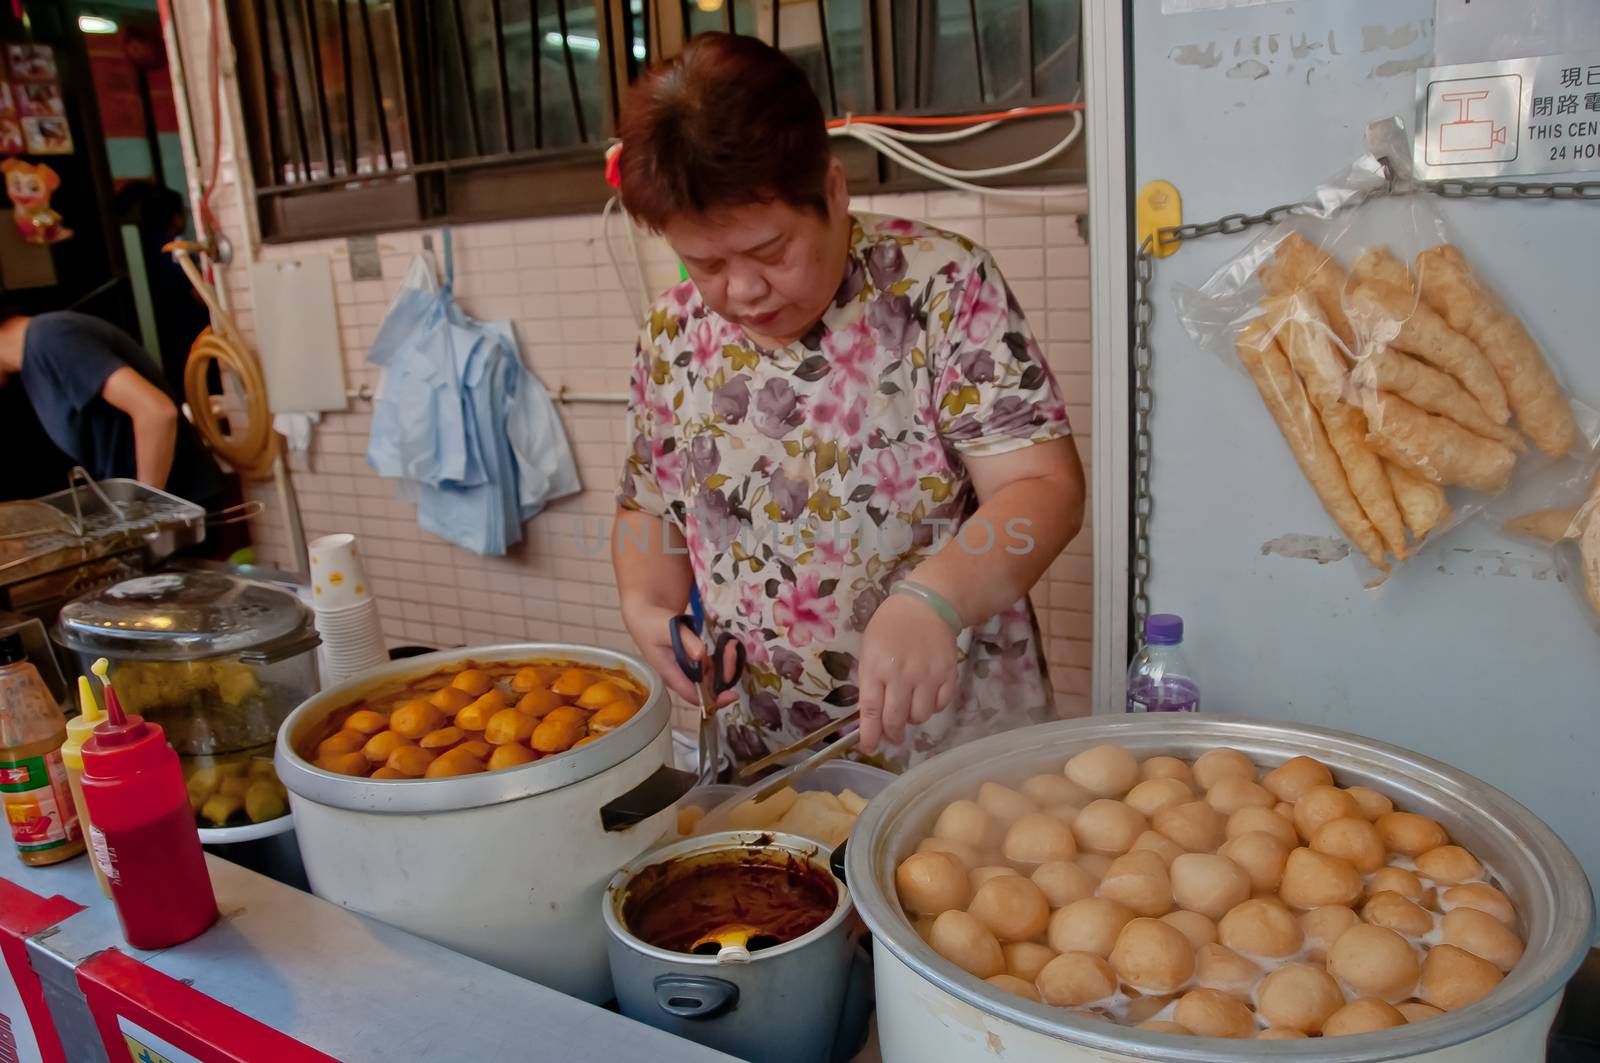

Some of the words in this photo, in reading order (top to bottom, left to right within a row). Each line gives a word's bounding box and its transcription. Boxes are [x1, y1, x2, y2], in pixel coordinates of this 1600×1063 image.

[1532, 92, 1600, 117] 閉路電
[1528, 124, 1562, 140] THIS
[1568, 121, 1600, 138] CEN
[1550, 146, 1566, 160] 24
[1573, 143, 1600, 159] HO
